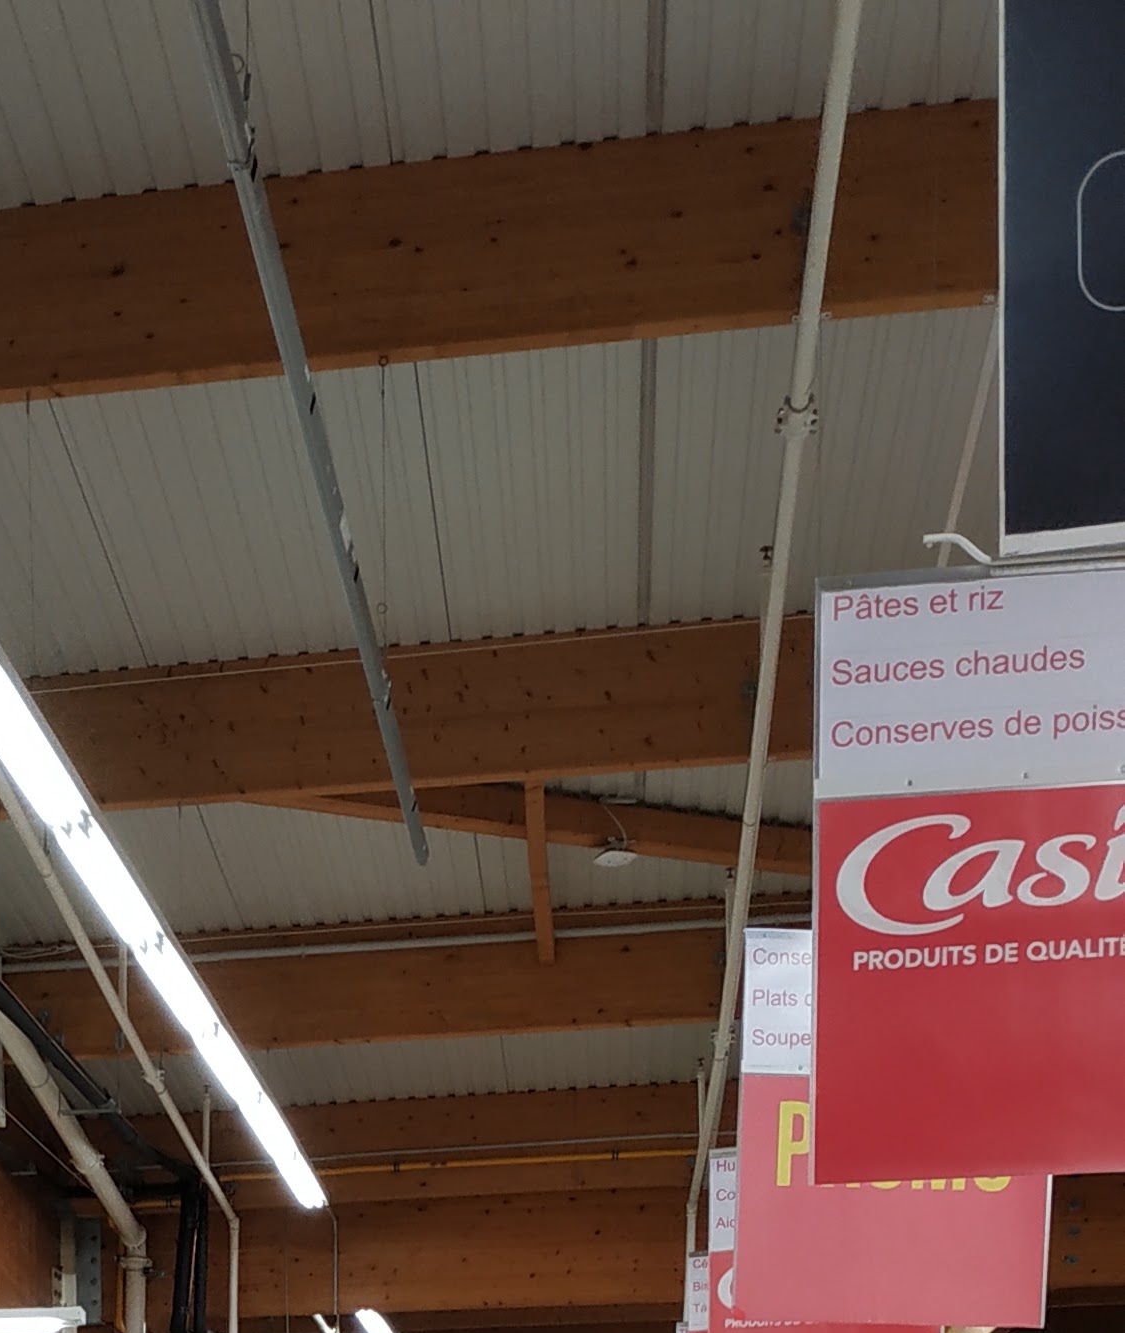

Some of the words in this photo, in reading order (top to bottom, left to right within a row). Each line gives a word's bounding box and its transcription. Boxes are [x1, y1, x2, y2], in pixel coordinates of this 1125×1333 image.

[832, 594, 919, 621] Pâtes
[929, 589, 958, 614] et
[969, 586, 1004, 611] riz
[832, 659, 945, 686] Sauces
[955, 646, 1085, 677] chaudes
[831, 717, 994, 748] Conserves
[1004, 710, 1041, 736] de
[853, 945, 976, 971] PRODUITS
[985, 943, 1019, 963] DE
[752, 989, 798, 1007] Plats
